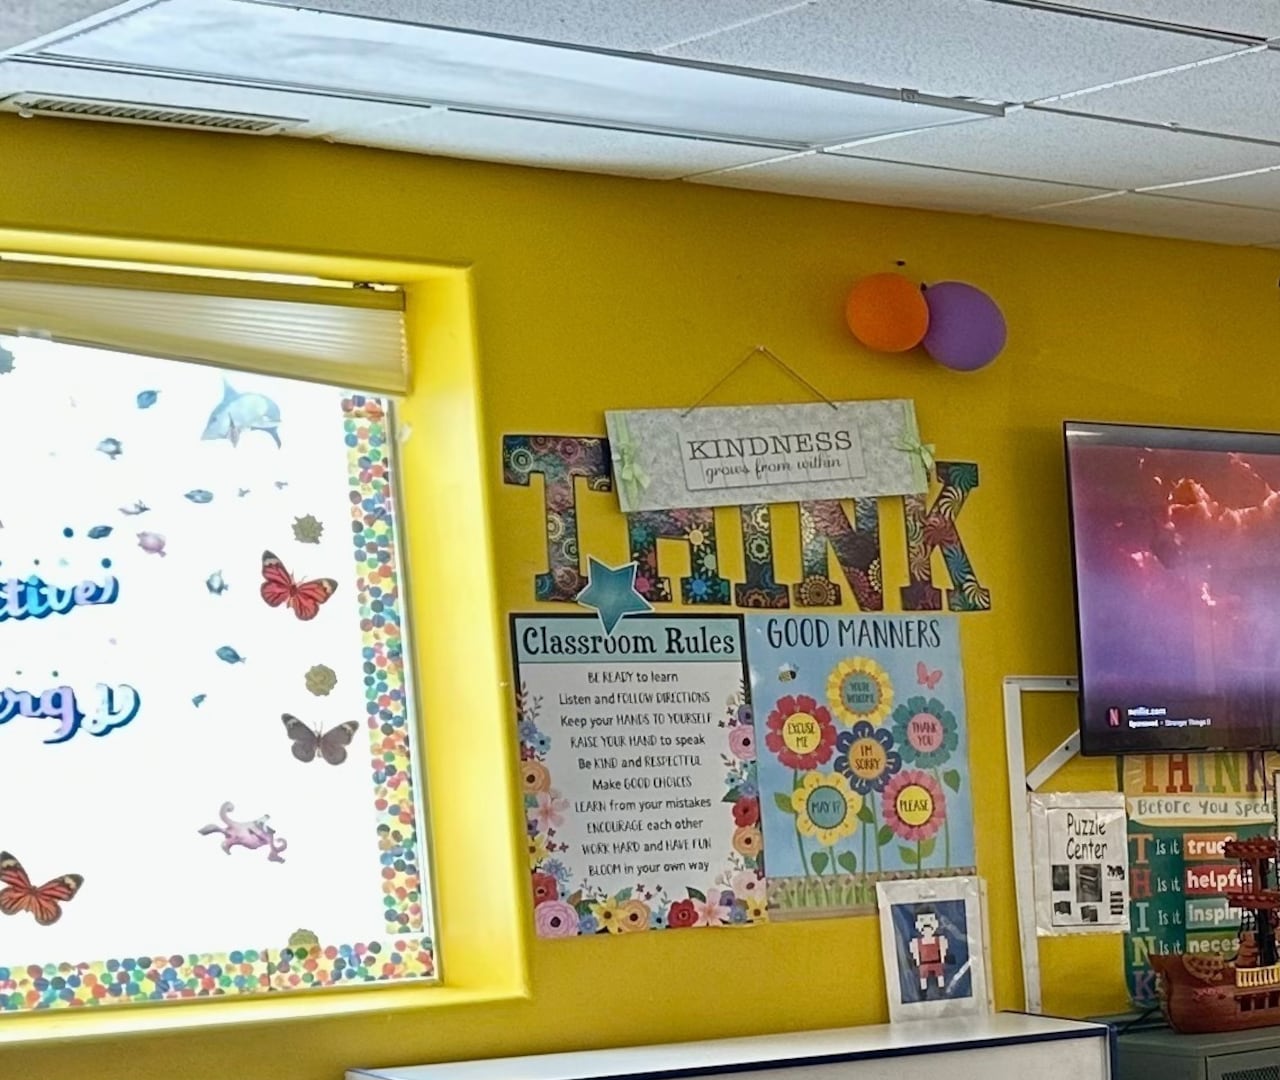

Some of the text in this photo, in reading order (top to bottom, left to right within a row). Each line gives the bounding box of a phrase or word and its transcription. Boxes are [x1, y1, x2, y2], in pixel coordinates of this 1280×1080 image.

[686, 430, 852, 460] KINDNESS
[705, 454, 842, 484] grows from within
[502, 433, 991, 613] THINK
[0, 574, 119, 622] tive
[522, 626, 735, 655] Classroom Rules
[766, 617, 942, 649] GOOD MANNERS
[588, 671, 679, 684] BE READY to learn
[559, 691, 711, 705] Listen and FOLLOW DIRECTIONS
[560, 712, 712, 729] Keep your HANDS TO YOURSELF
[1109, 708, 1119, 726] N
[787, 721, 816, 735] EXCUSE
[911, 721, 938, 733] THANK
[570, 733, 706, 749] RAISE YOUR HAND to speak
[796, 735, 808, 748] ME
[917, 734, 934, 746] YOU
[578, 754, 702, 770] Be KIND and RESPECTFUL
[855, 757, 881, 771] SORRY
[592, 775, 693, 790] Make GOOD CHOICES
[574, 796, 712, 813] LEARN from your mistakes
[811, 800, 829, 814] MAY
[900, 799, 930, 812] PLEASE
[1137, 799, 1190, 816] Before
[1199, 799, 1228, 815] You
[586, 817, 704, 834] ENCOURAGE each other
[1066, 811, 1107, 836] Puzzle
[581, 837, 712, 855] WORK HARD and HAVE FUN
[1066, 836, 1108, 860] Center
[1128, 834, 1179, 864] T Is it
[588, 860, 710, 877] BLOOM in your own way
[1130, 869, 1180, 898] H Is it
[1136, 902, 1182, 933] I Is it
[1159, 940, 1169, 955] Is
[1173, 940, 1183, 955] it
